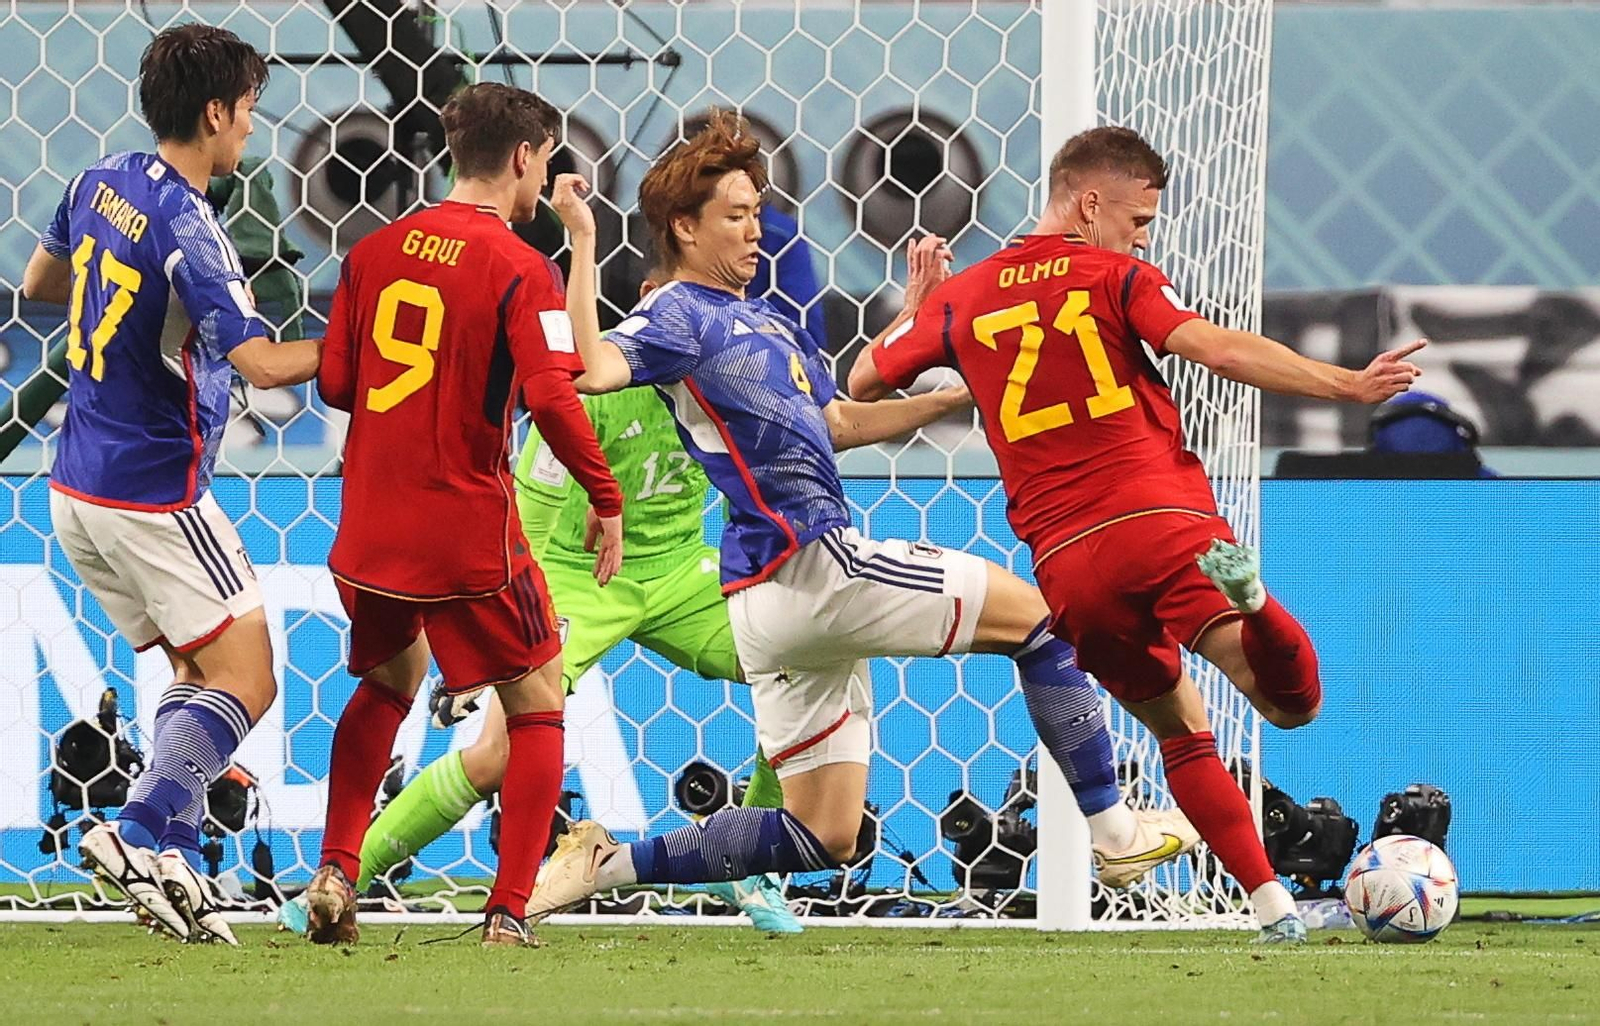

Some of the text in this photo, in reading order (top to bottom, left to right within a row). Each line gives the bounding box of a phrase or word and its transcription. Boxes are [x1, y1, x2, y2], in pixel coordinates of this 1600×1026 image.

[90, 182, 149, 242] TANAKA
[401, 228, 468, 268] GAVI
[998, 256, 1071, 288] OLMO
[65, 234, 142, 383] 17
[366, 278, 445, 413] 9
[972, 290, 1135, 443] 21
[636, 451, 691, 500] 12
